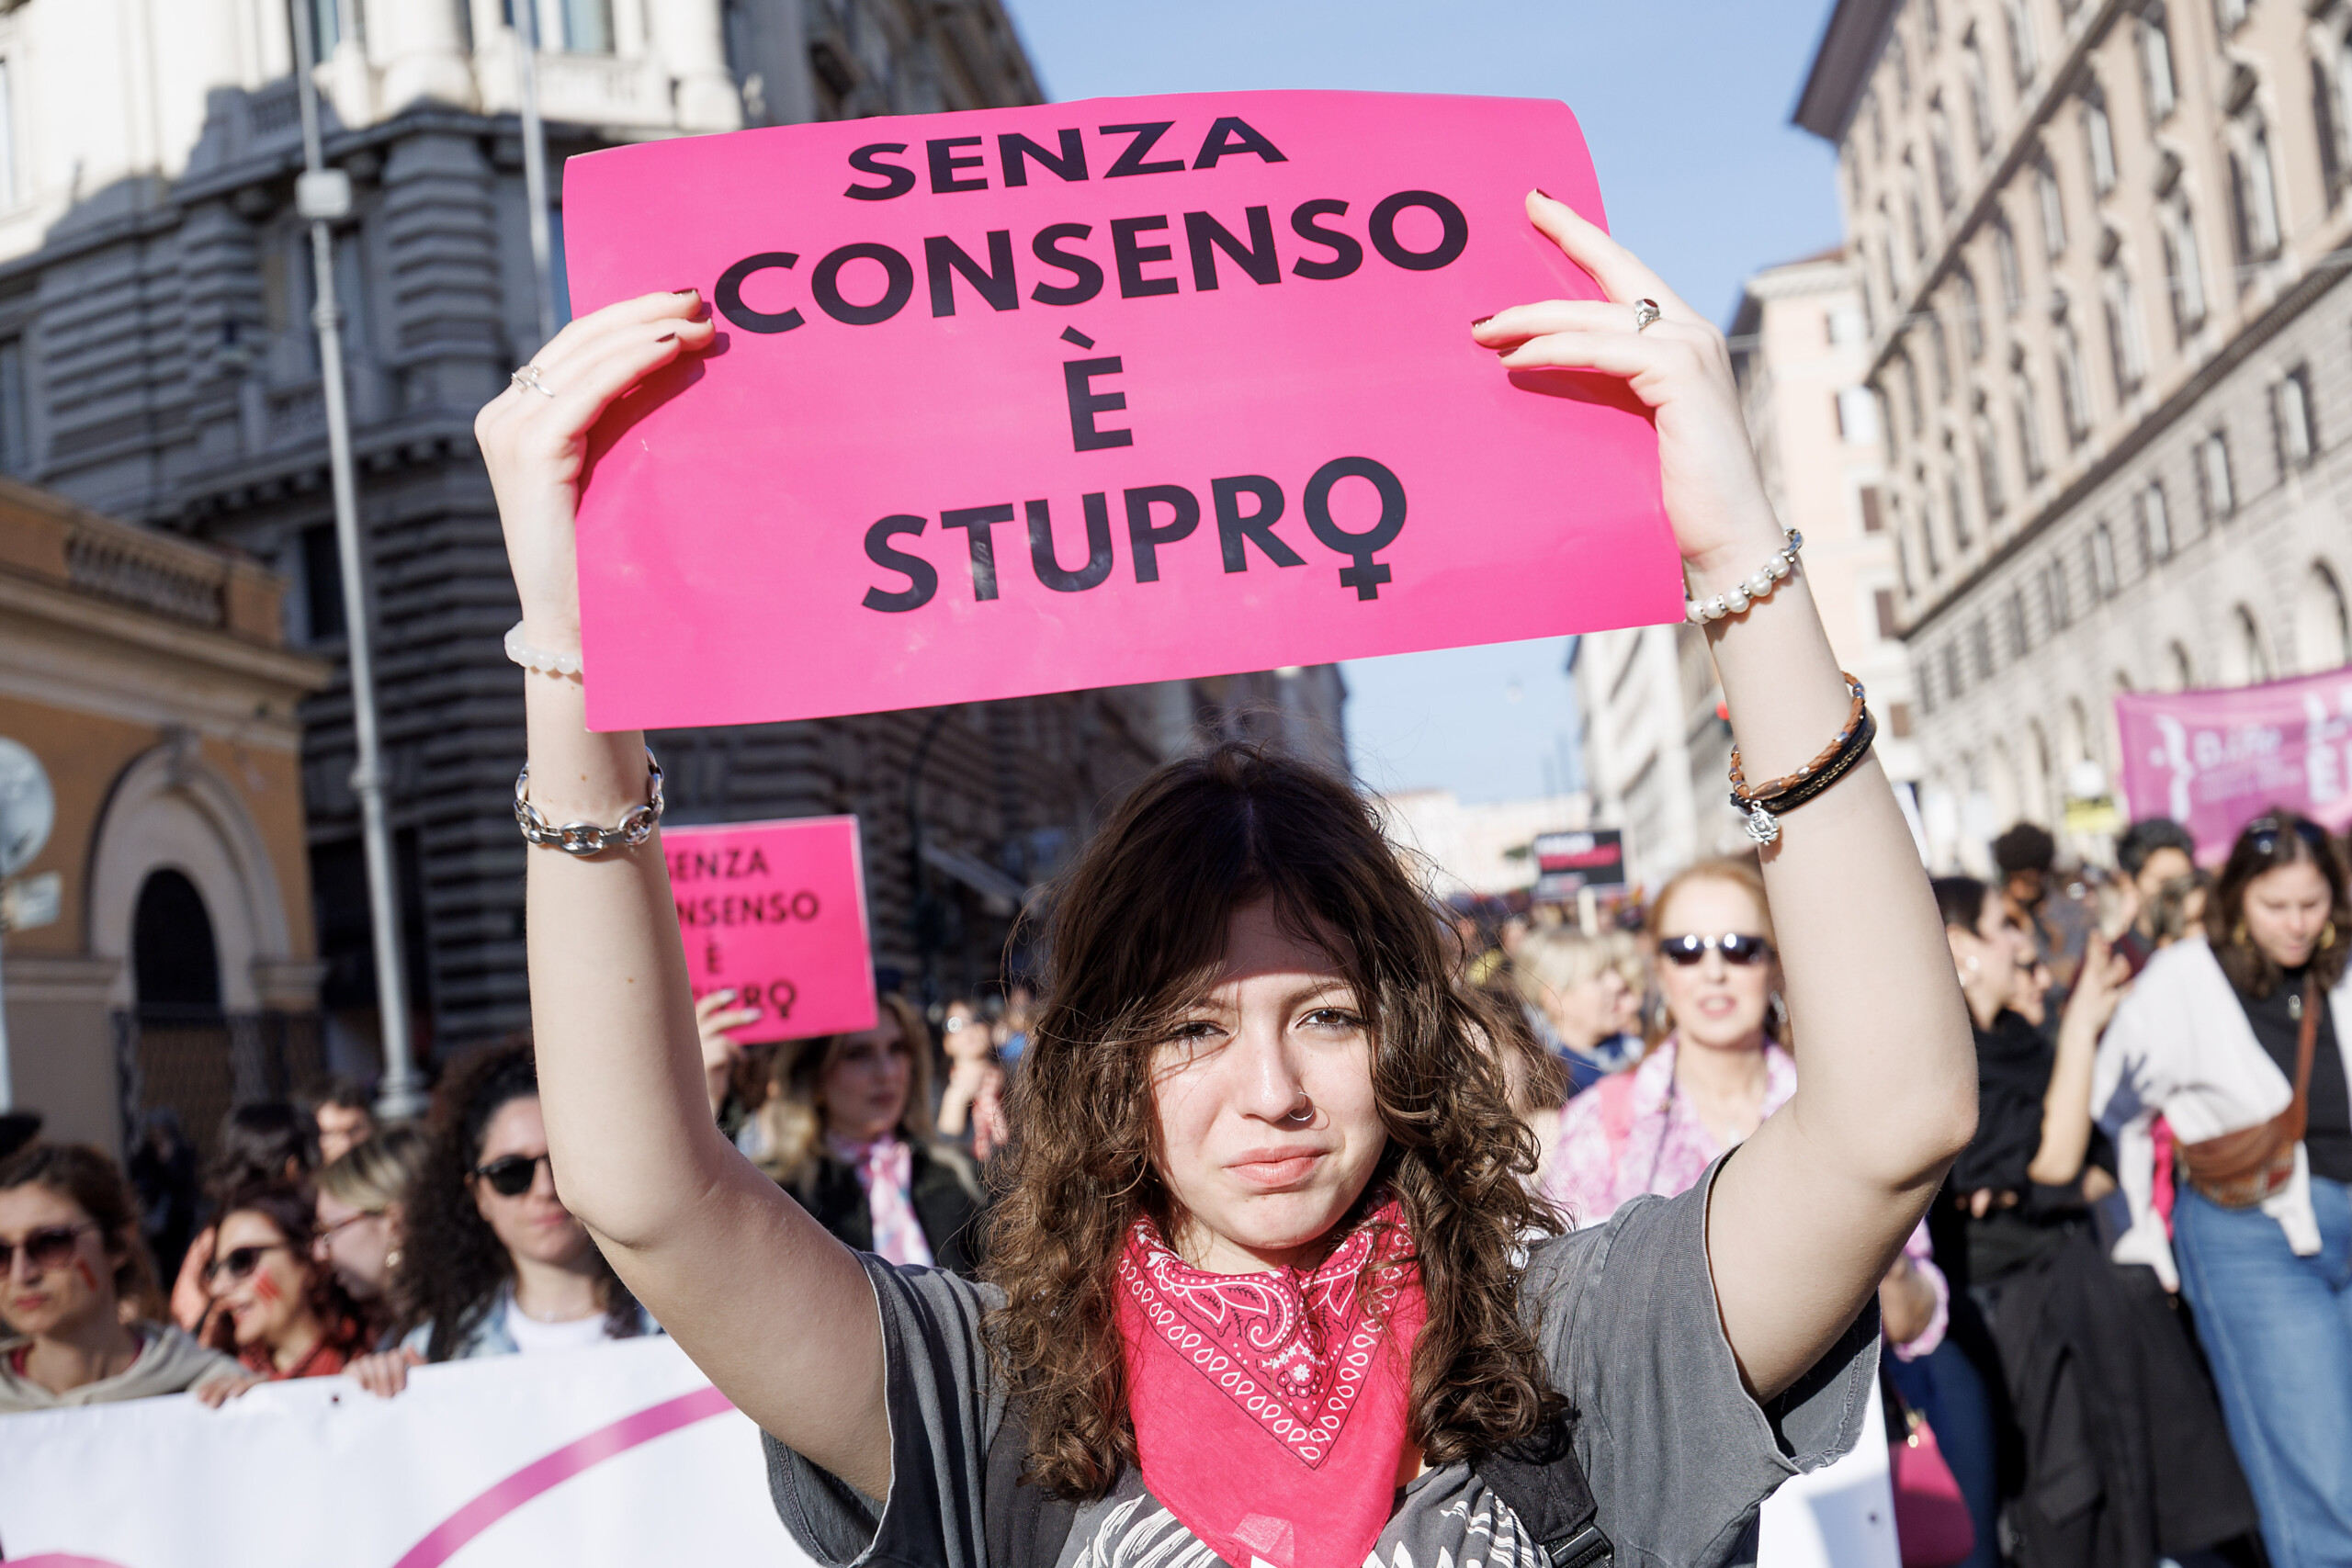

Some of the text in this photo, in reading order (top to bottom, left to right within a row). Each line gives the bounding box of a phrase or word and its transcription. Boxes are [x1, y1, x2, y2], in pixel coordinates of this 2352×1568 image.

[844, 116, 1288, 201] SENZA
[715, 190, 1468, 334] CONSENSO
[1061, 325, 1133, 452] È
[863, 457, 1407, 613] STUPRO
[675, 889, 820, 927] NSENSO
